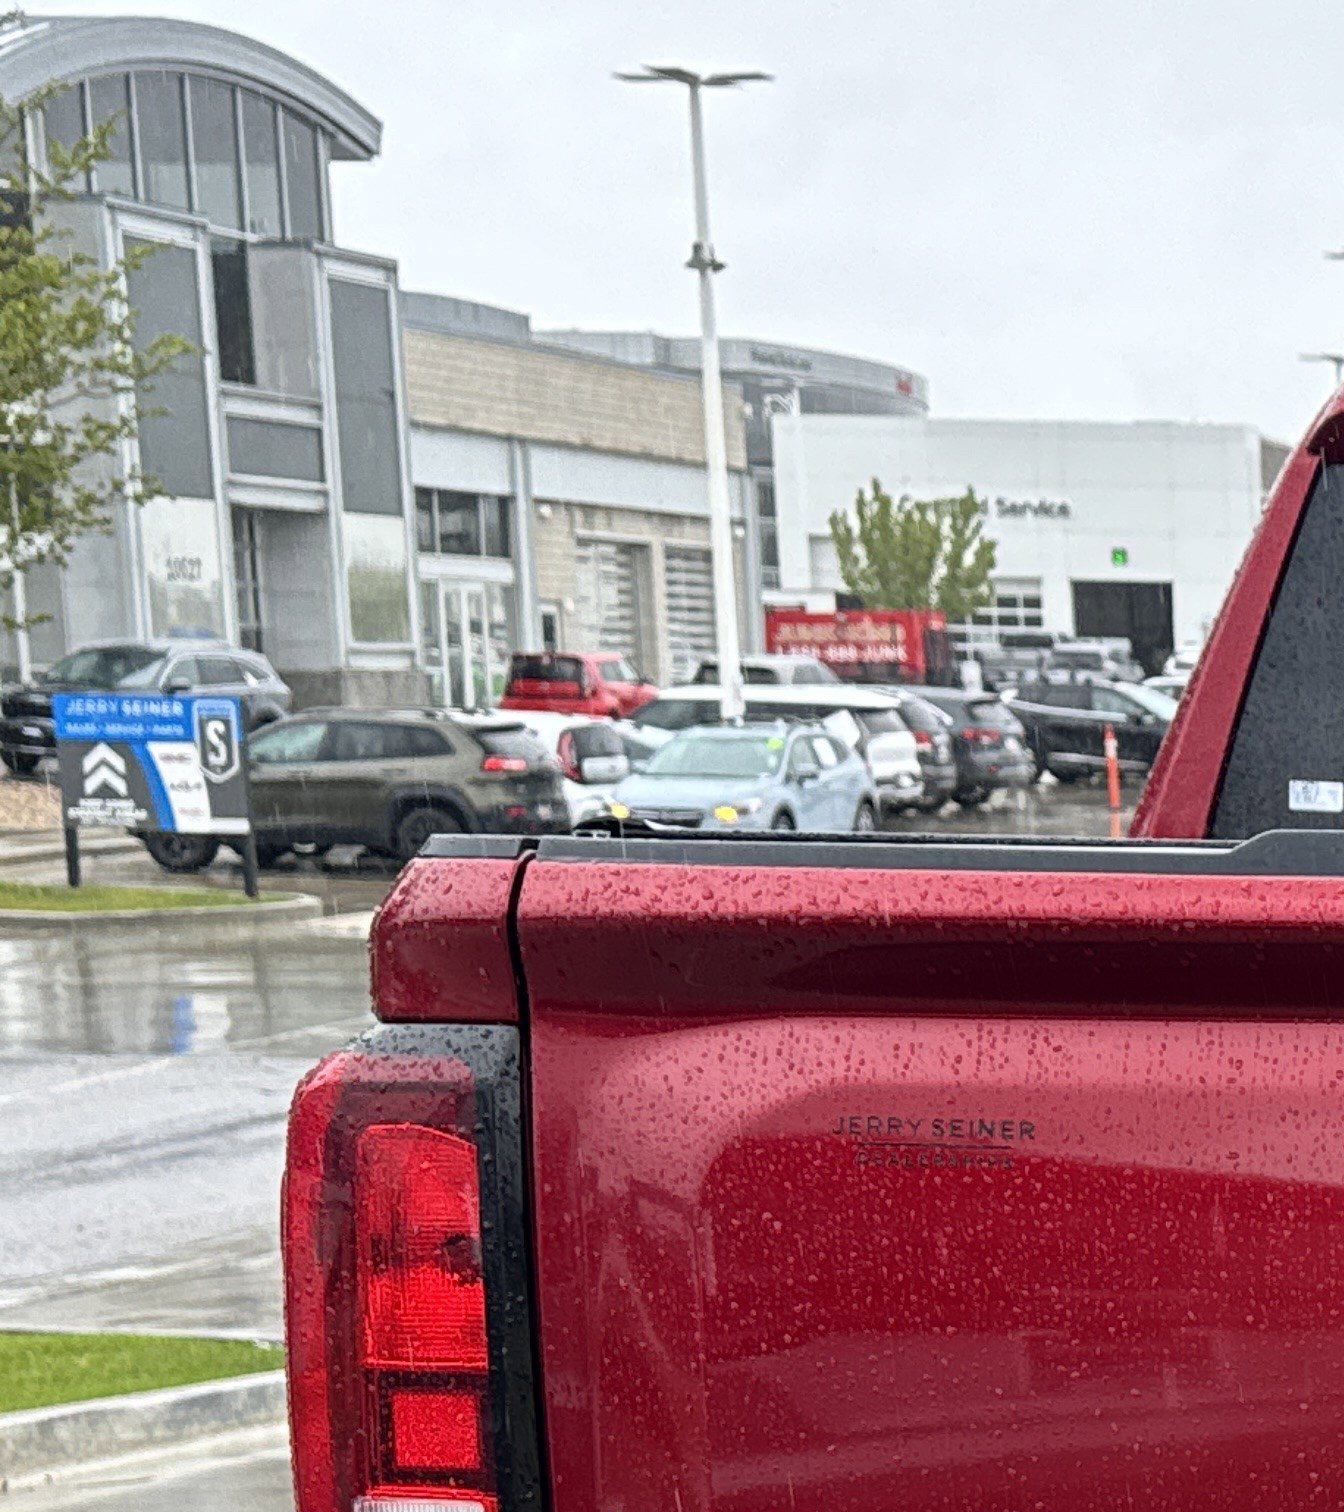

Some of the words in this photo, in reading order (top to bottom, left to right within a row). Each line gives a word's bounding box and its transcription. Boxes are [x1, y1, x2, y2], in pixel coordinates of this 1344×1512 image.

[64, 699, 117, 717] JERRY
[120, 699, 184, 717] SEINER
[832, 1115, 924, 1137] JERRY
[931, 1118, 1036, 1141] SEINER
[856, 1151, 1014, 1169] DEALERSHIPS
